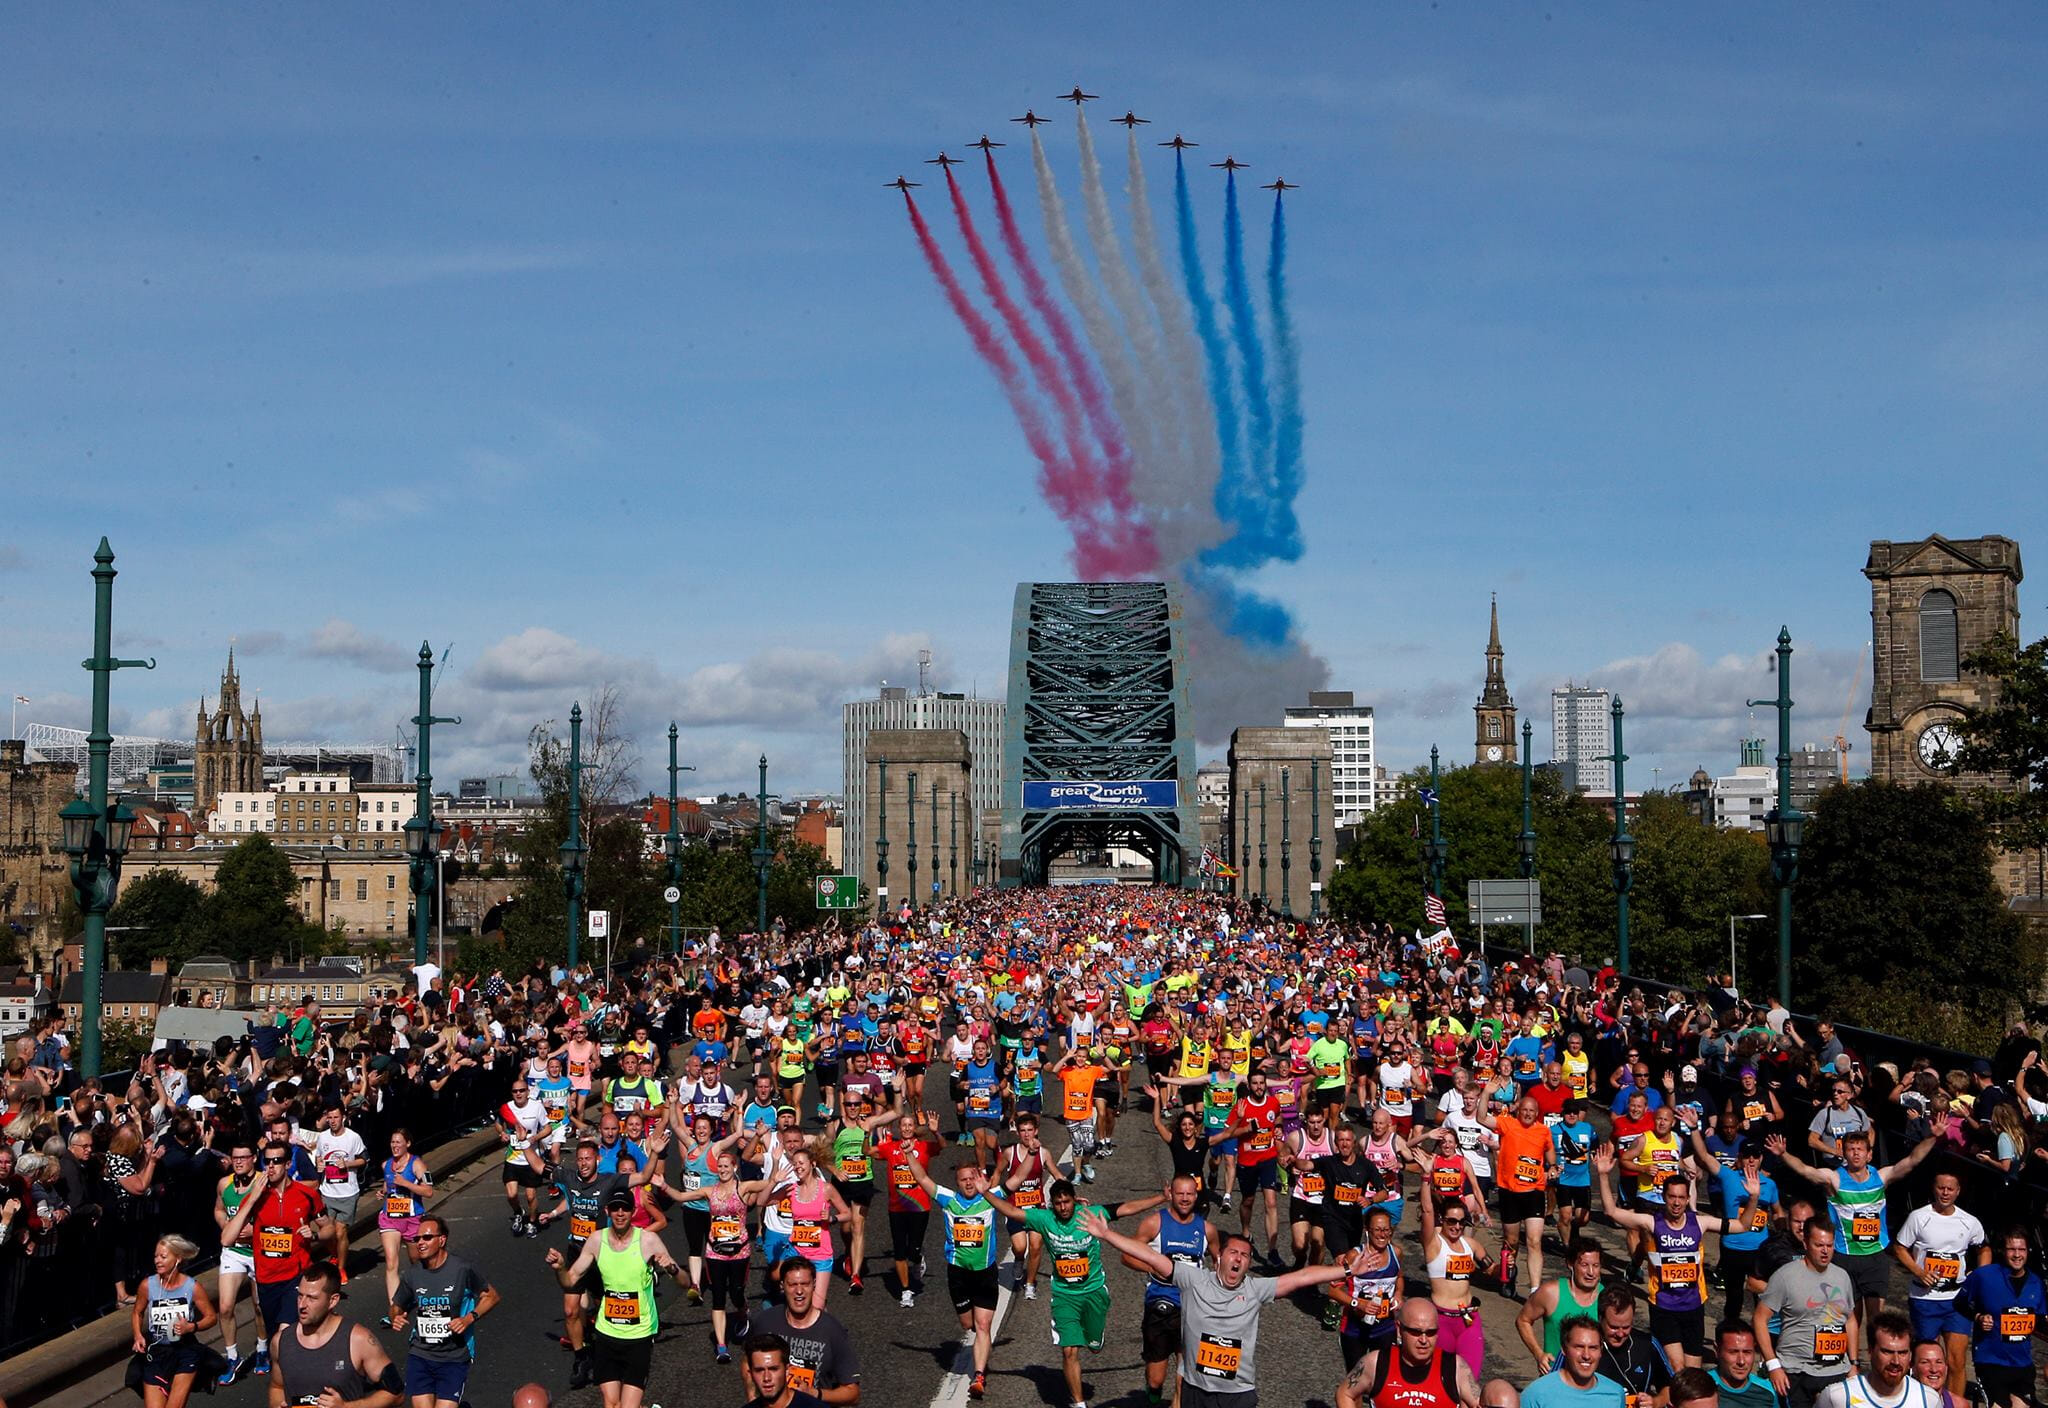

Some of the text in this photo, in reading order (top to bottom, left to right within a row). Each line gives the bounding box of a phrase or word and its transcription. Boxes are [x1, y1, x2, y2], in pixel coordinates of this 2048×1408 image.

[1050, 785, 1143, 798] great north
[1121, 796, 1148, 804] run
[666, 890, 679, 898] 40
[1518, 1165, 1538, 1177] 5189
[1437, 1176, 1458, 1185] 7663
[387, 1201, 409, 1210] 13092
[573, 1194, 599, 1206] Team
[1017, 1194, 1040, 1205] 13269
[572, 1222, 593, 1235] 7754
[955, 1228, 984, 1239] 13879
[1856, 1223, 1879, 1233] 7996
[260, 1237, 291, 1249] 12453
[1660, 1233, 1696, 1248] Stroke
[1059, 1263, 1087, 1276] 12601
[1663, 1268, 1696, 1280] 15263
[418, 1295, 450, 1307] Team
[436, 1303, 451, 1311] Run
[607, 1303, 636, 1316] 7329
[419, 1323, 450, 1335] 16659
[2003, 1320, 2033, 1333] 12374
[790, 1336, 826, 1352] HAPPY
[1819, 1339, 1846, 1351] 13691
[790, 1346, 824, 1362] HAPPY
[1200, 1349, 1238, 1368] 11426
[1394, 1390, 1437, 1404] LARNE
[1408, 1397, 1423, 1407] A.C.
